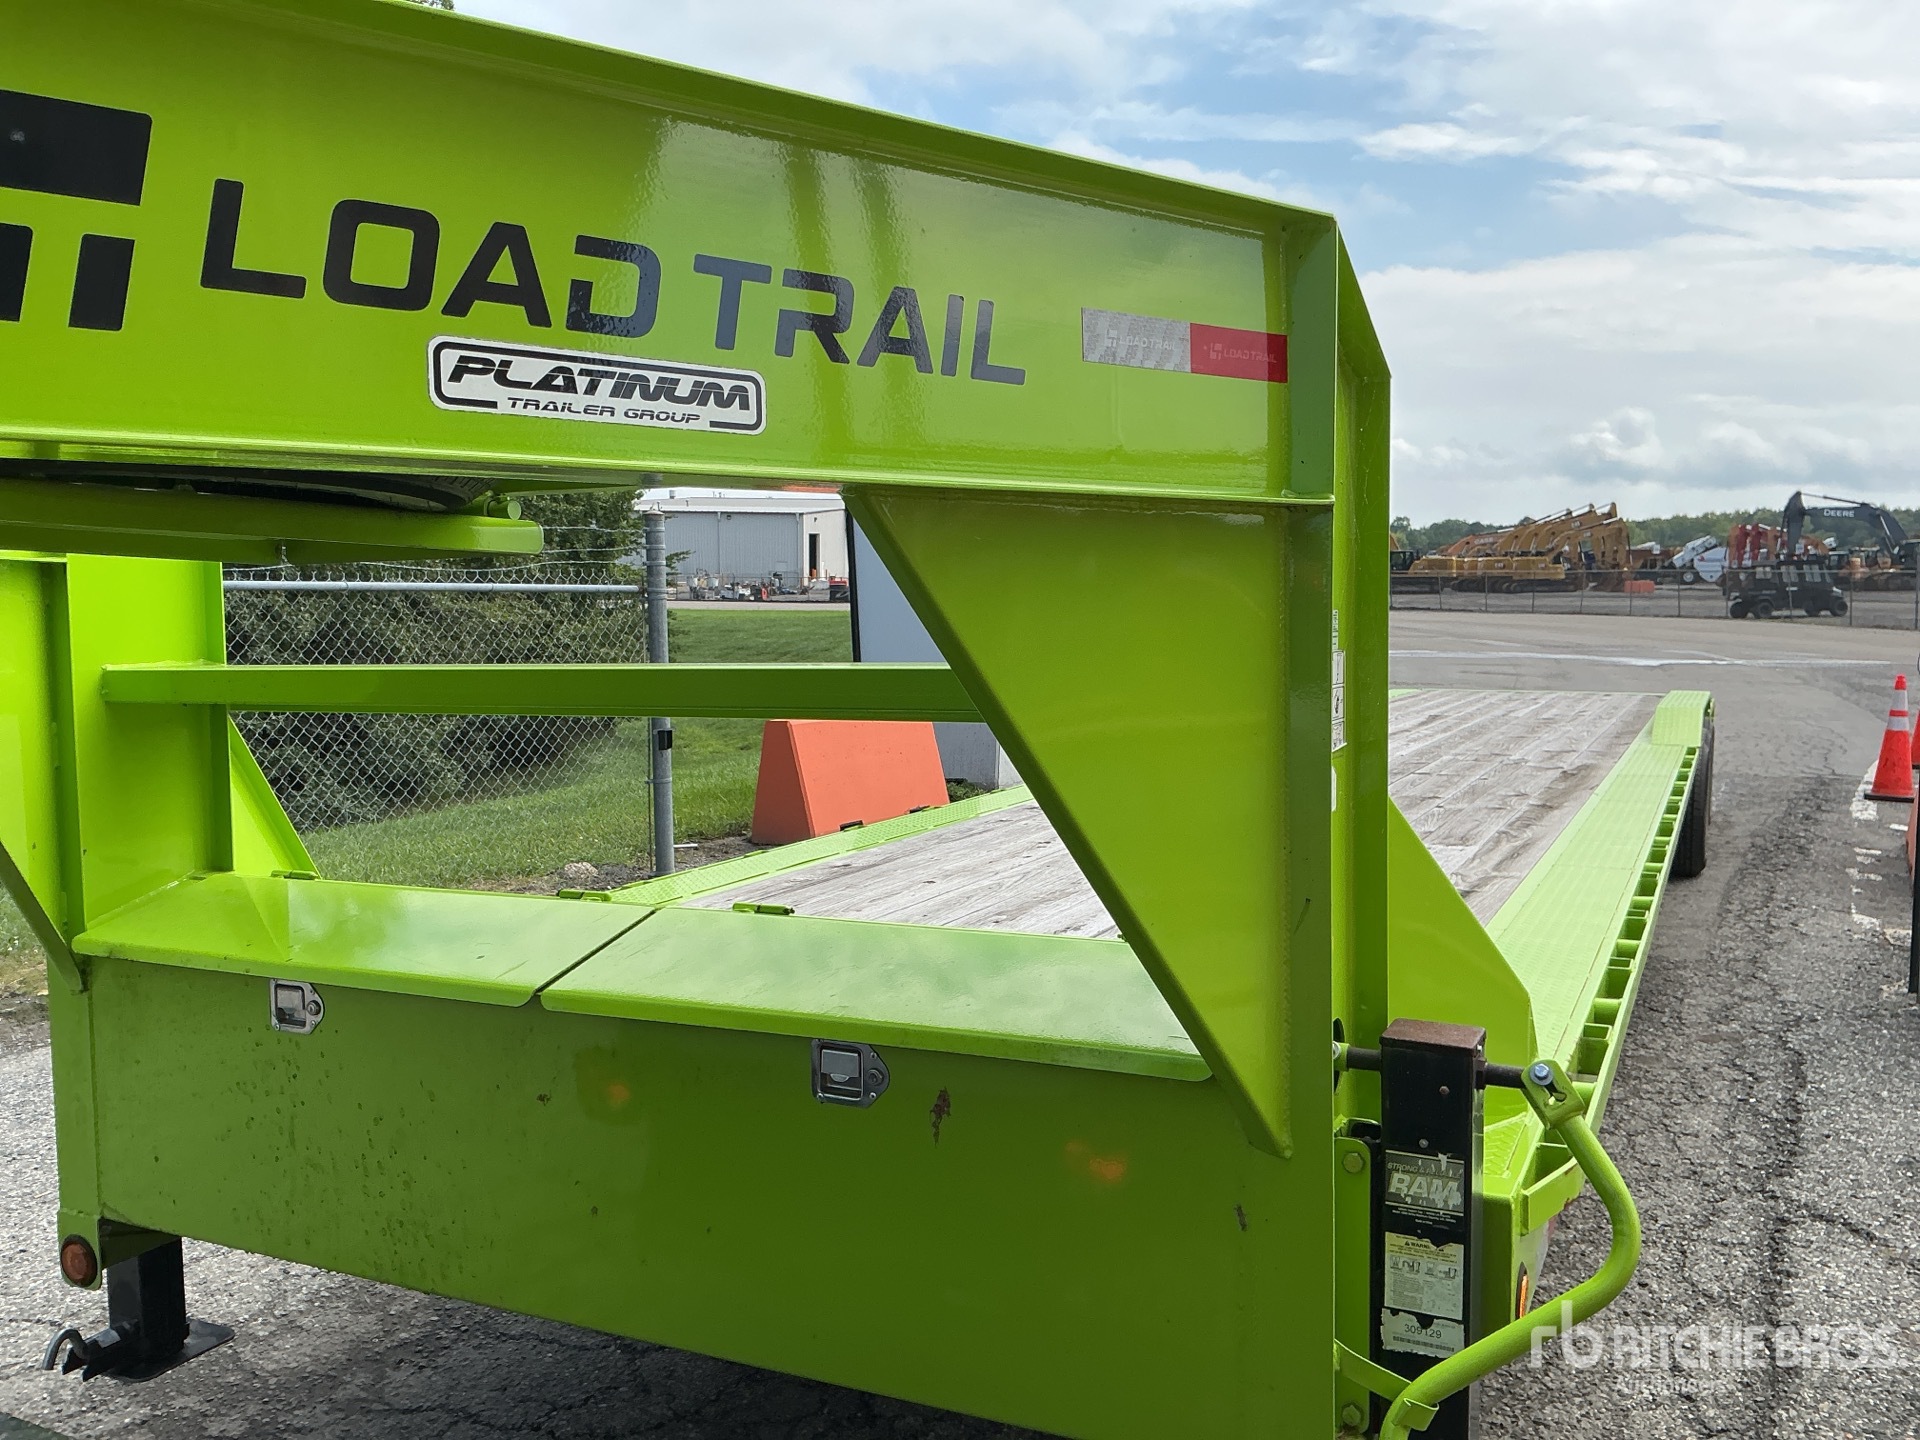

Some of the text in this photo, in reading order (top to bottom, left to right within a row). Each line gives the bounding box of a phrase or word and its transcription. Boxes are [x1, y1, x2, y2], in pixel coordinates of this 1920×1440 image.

[200, 178, 1026, 386] LOAD TRAIL
[447, 354, 751, 411] PLATINUM
[506, 396, 701, 424] TRAILER GROUP
[1823, 508, 1855, 518] DEERE
[1387, 1162, 1419, 1173] STRONG
[1388, 1172, 1461, 1206] RAM
[1404, 1323, 1442, 1339] 309129
